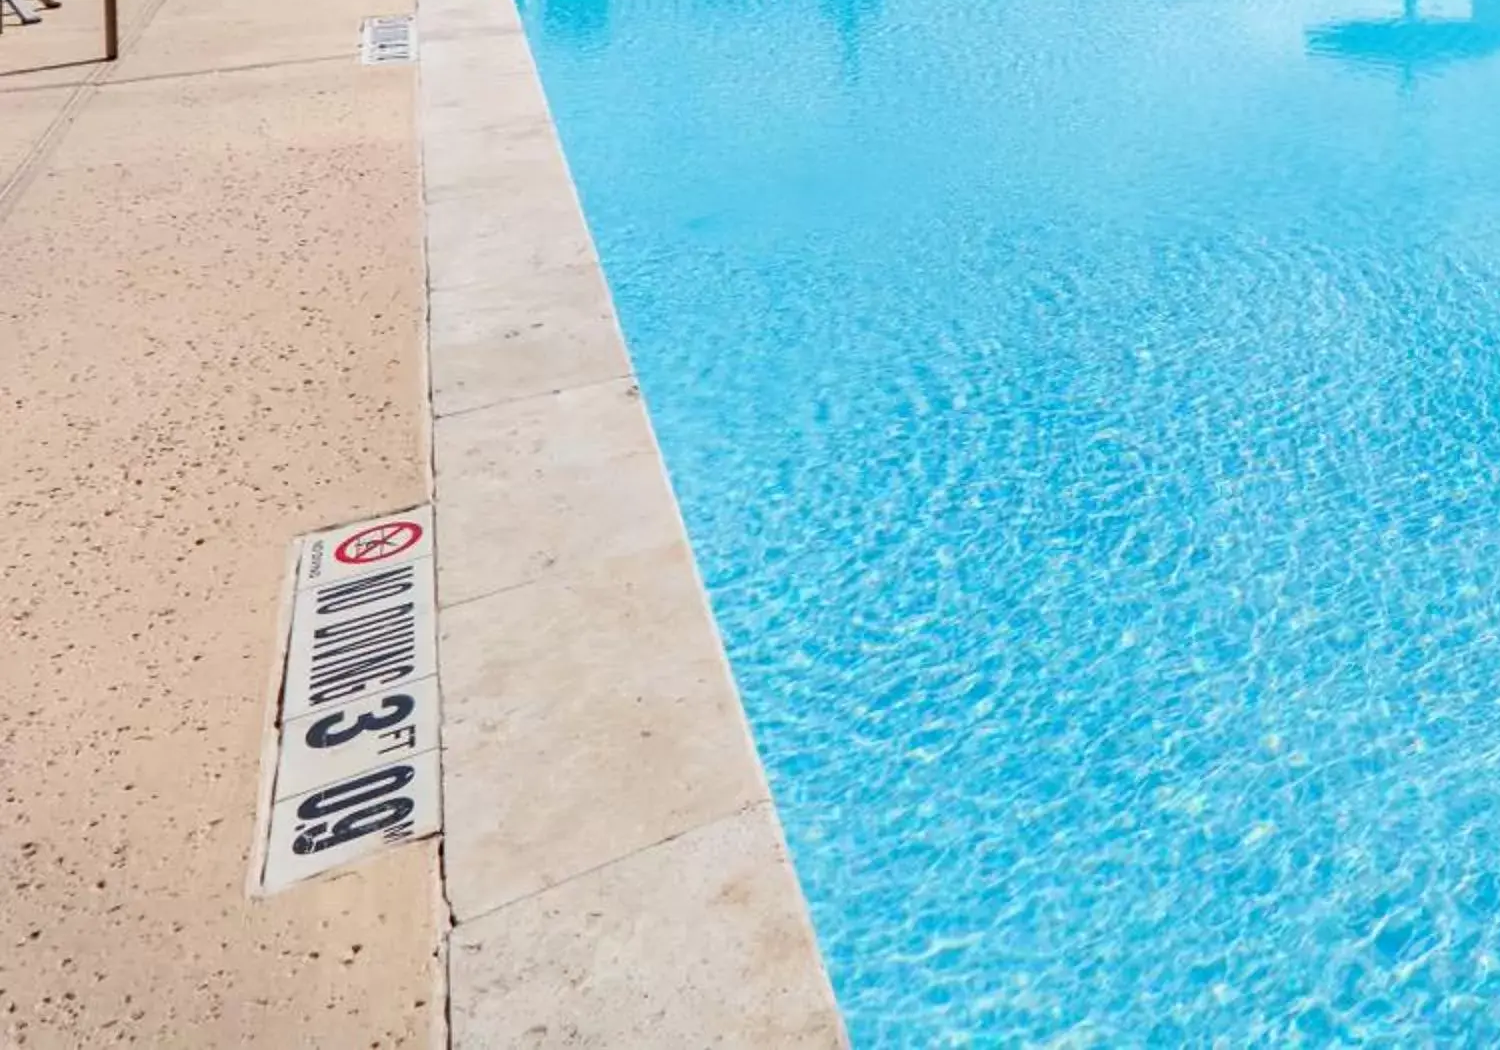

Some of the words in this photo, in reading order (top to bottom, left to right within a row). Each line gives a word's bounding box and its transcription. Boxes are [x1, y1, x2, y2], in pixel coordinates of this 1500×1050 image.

[316, 564, 415, 615] NO
[309, 602, 416, 707] DIVING
[305, 692, 416, 749] 3
